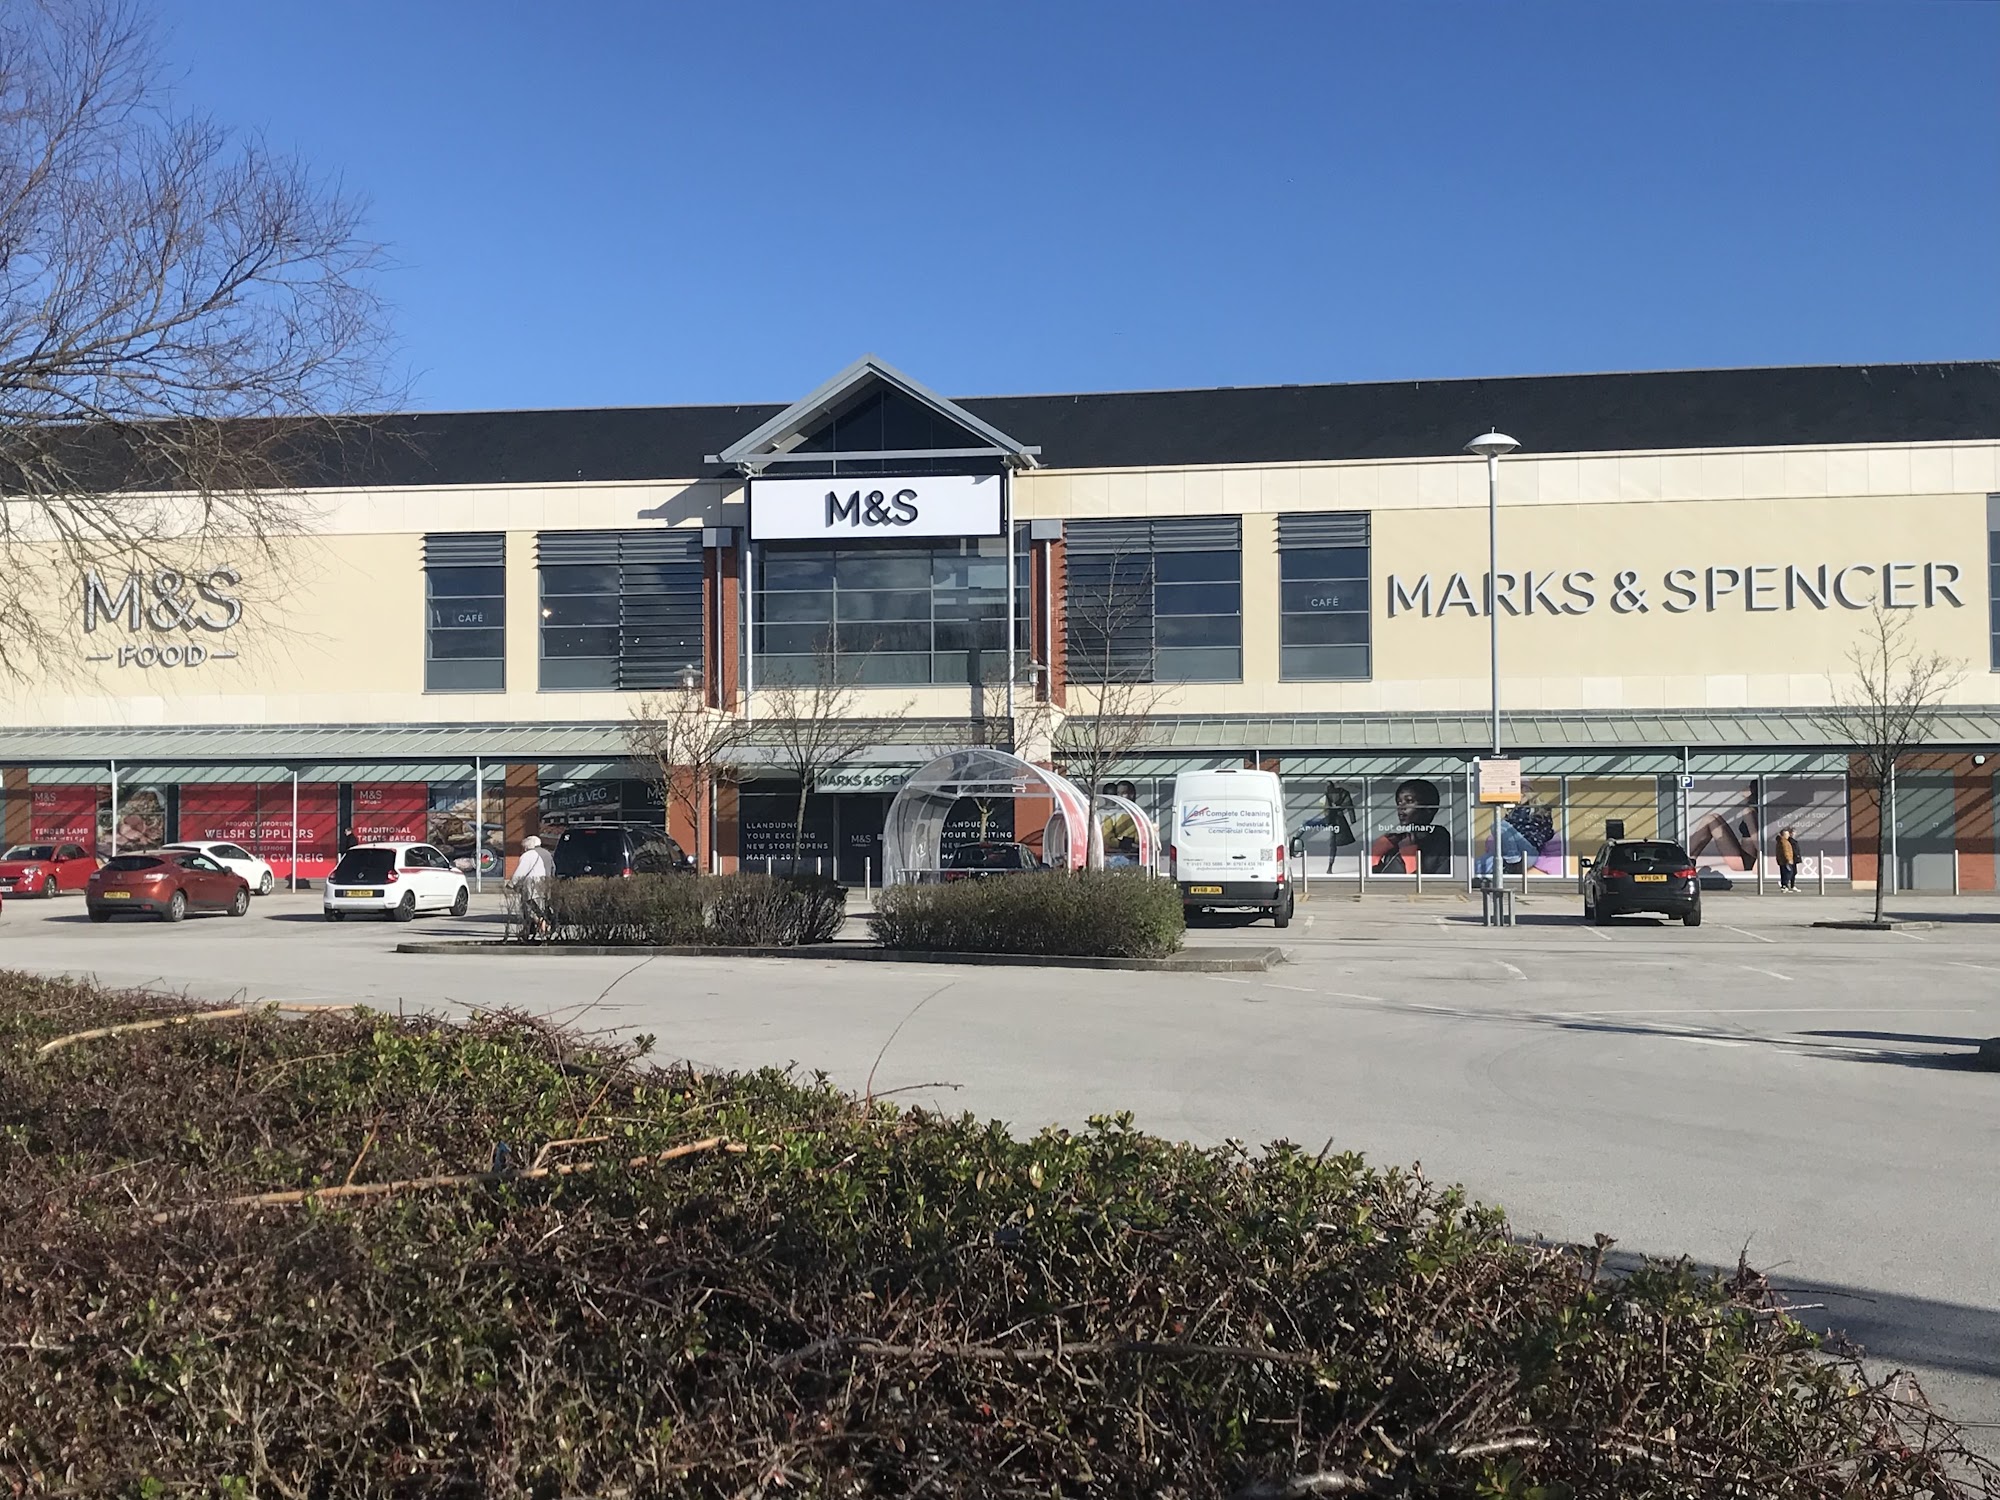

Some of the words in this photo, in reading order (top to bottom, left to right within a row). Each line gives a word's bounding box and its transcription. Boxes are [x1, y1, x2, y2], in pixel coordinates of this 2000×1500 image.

[827, 489, 919, 524] M&S
[1386, 571, 1597, 618] MARKS
[1608, 568, 1650, 614] &
[1661, 561, 1966, 613] SPENCER
[83, 564, 243, 634] M&S
[1311, 595, 1339, 607] CAFÉ
[458, 611, 484, 623] CAFÉ
[117, 643, 208, 668] FOOD
[817, 774, 862, 786] MARKS
[863, 774, 872, 786] &
[874, 774, 910, 786] SPEN
[35, 792, 57, 801] M&S
[360, 789, 383, 800] M&S
[558, 793, 577, 807] FRUIT
[585, 787, 607, 801] VEG
[1206, 810, 1238, 818] Complete
[1240, 810, 1270, 818] Cleaning
[357, 826, 412, 834] TRADITIONAL
[944, 821, 999, 829] LANDUDO,
[1298, 823, 1341, 835] Anything
[1378, 823, 1393, 832] but
[1396, 823, 1436, 835] ordinary
[35, 827, 65, 835] TENDER
[66, 827, 89, 835] LAMB
[205, 829, 245, 839] WELSH
[746, 832, 771, 840] YOUR
[774, 832, 816, 840] EXCIING
[942, 831, 967, 839] YOUR
[357, 834, 387, 842] TREATS
[389, 834, 417, 842] BAKED
[851, 834, 871, 843] M&S
[746, 842, 765, 850] NEW
[799, 842, 829, 850] OPENS
